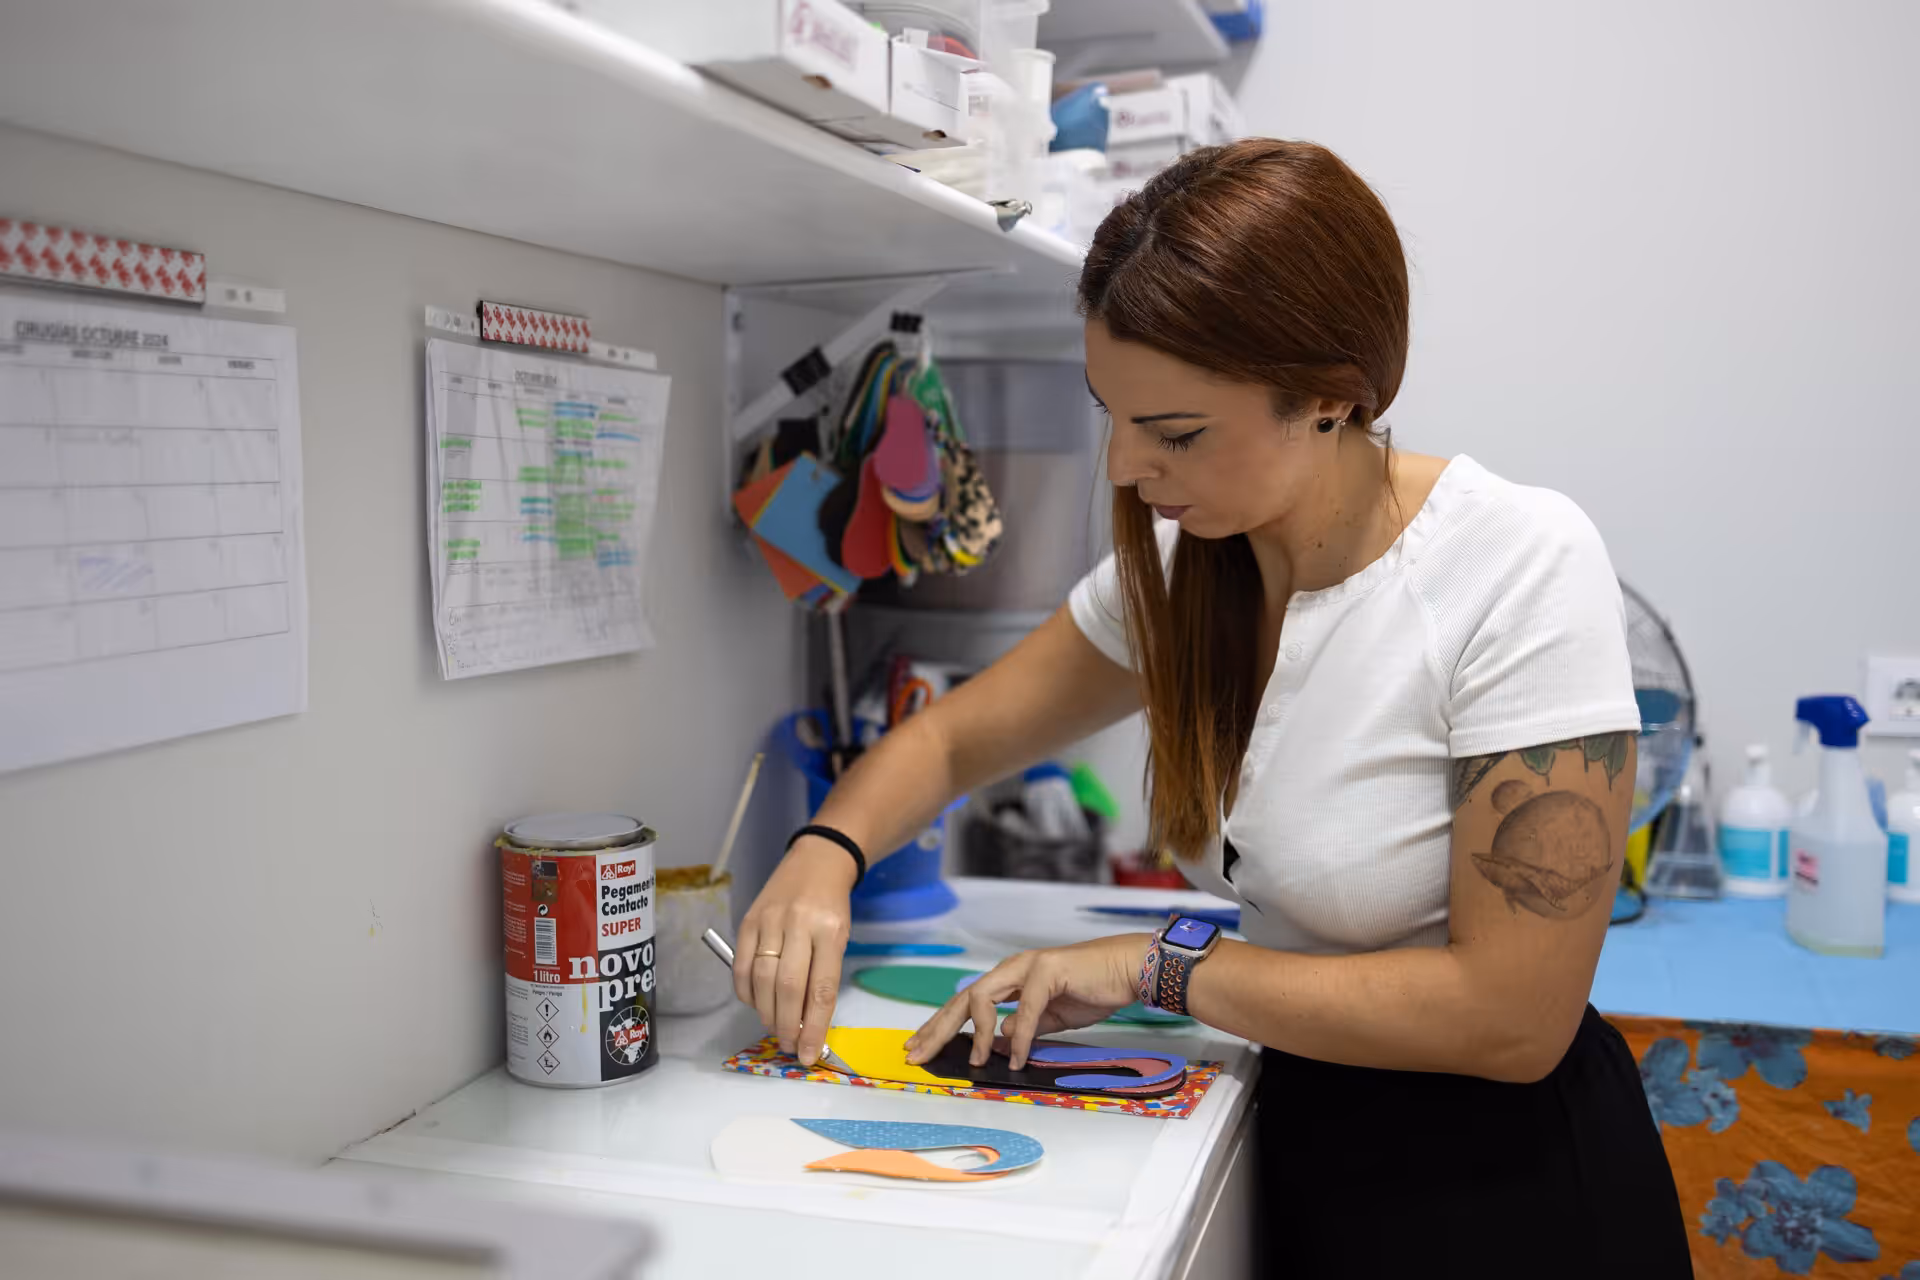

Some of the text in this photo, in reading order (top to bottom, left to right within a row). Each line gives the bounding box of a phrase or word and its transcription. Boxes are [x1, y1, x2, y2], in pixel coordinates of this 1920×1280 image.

[617, 862, 635, 874] Rayt
[601, 895, 648, 916] Contacto
[601, 917, 641, 937] SUPER
[568, 943, 654, 980] novo
[533, 970, 560, 983] 1 litro
[599, 966, 656, 1013] pre
